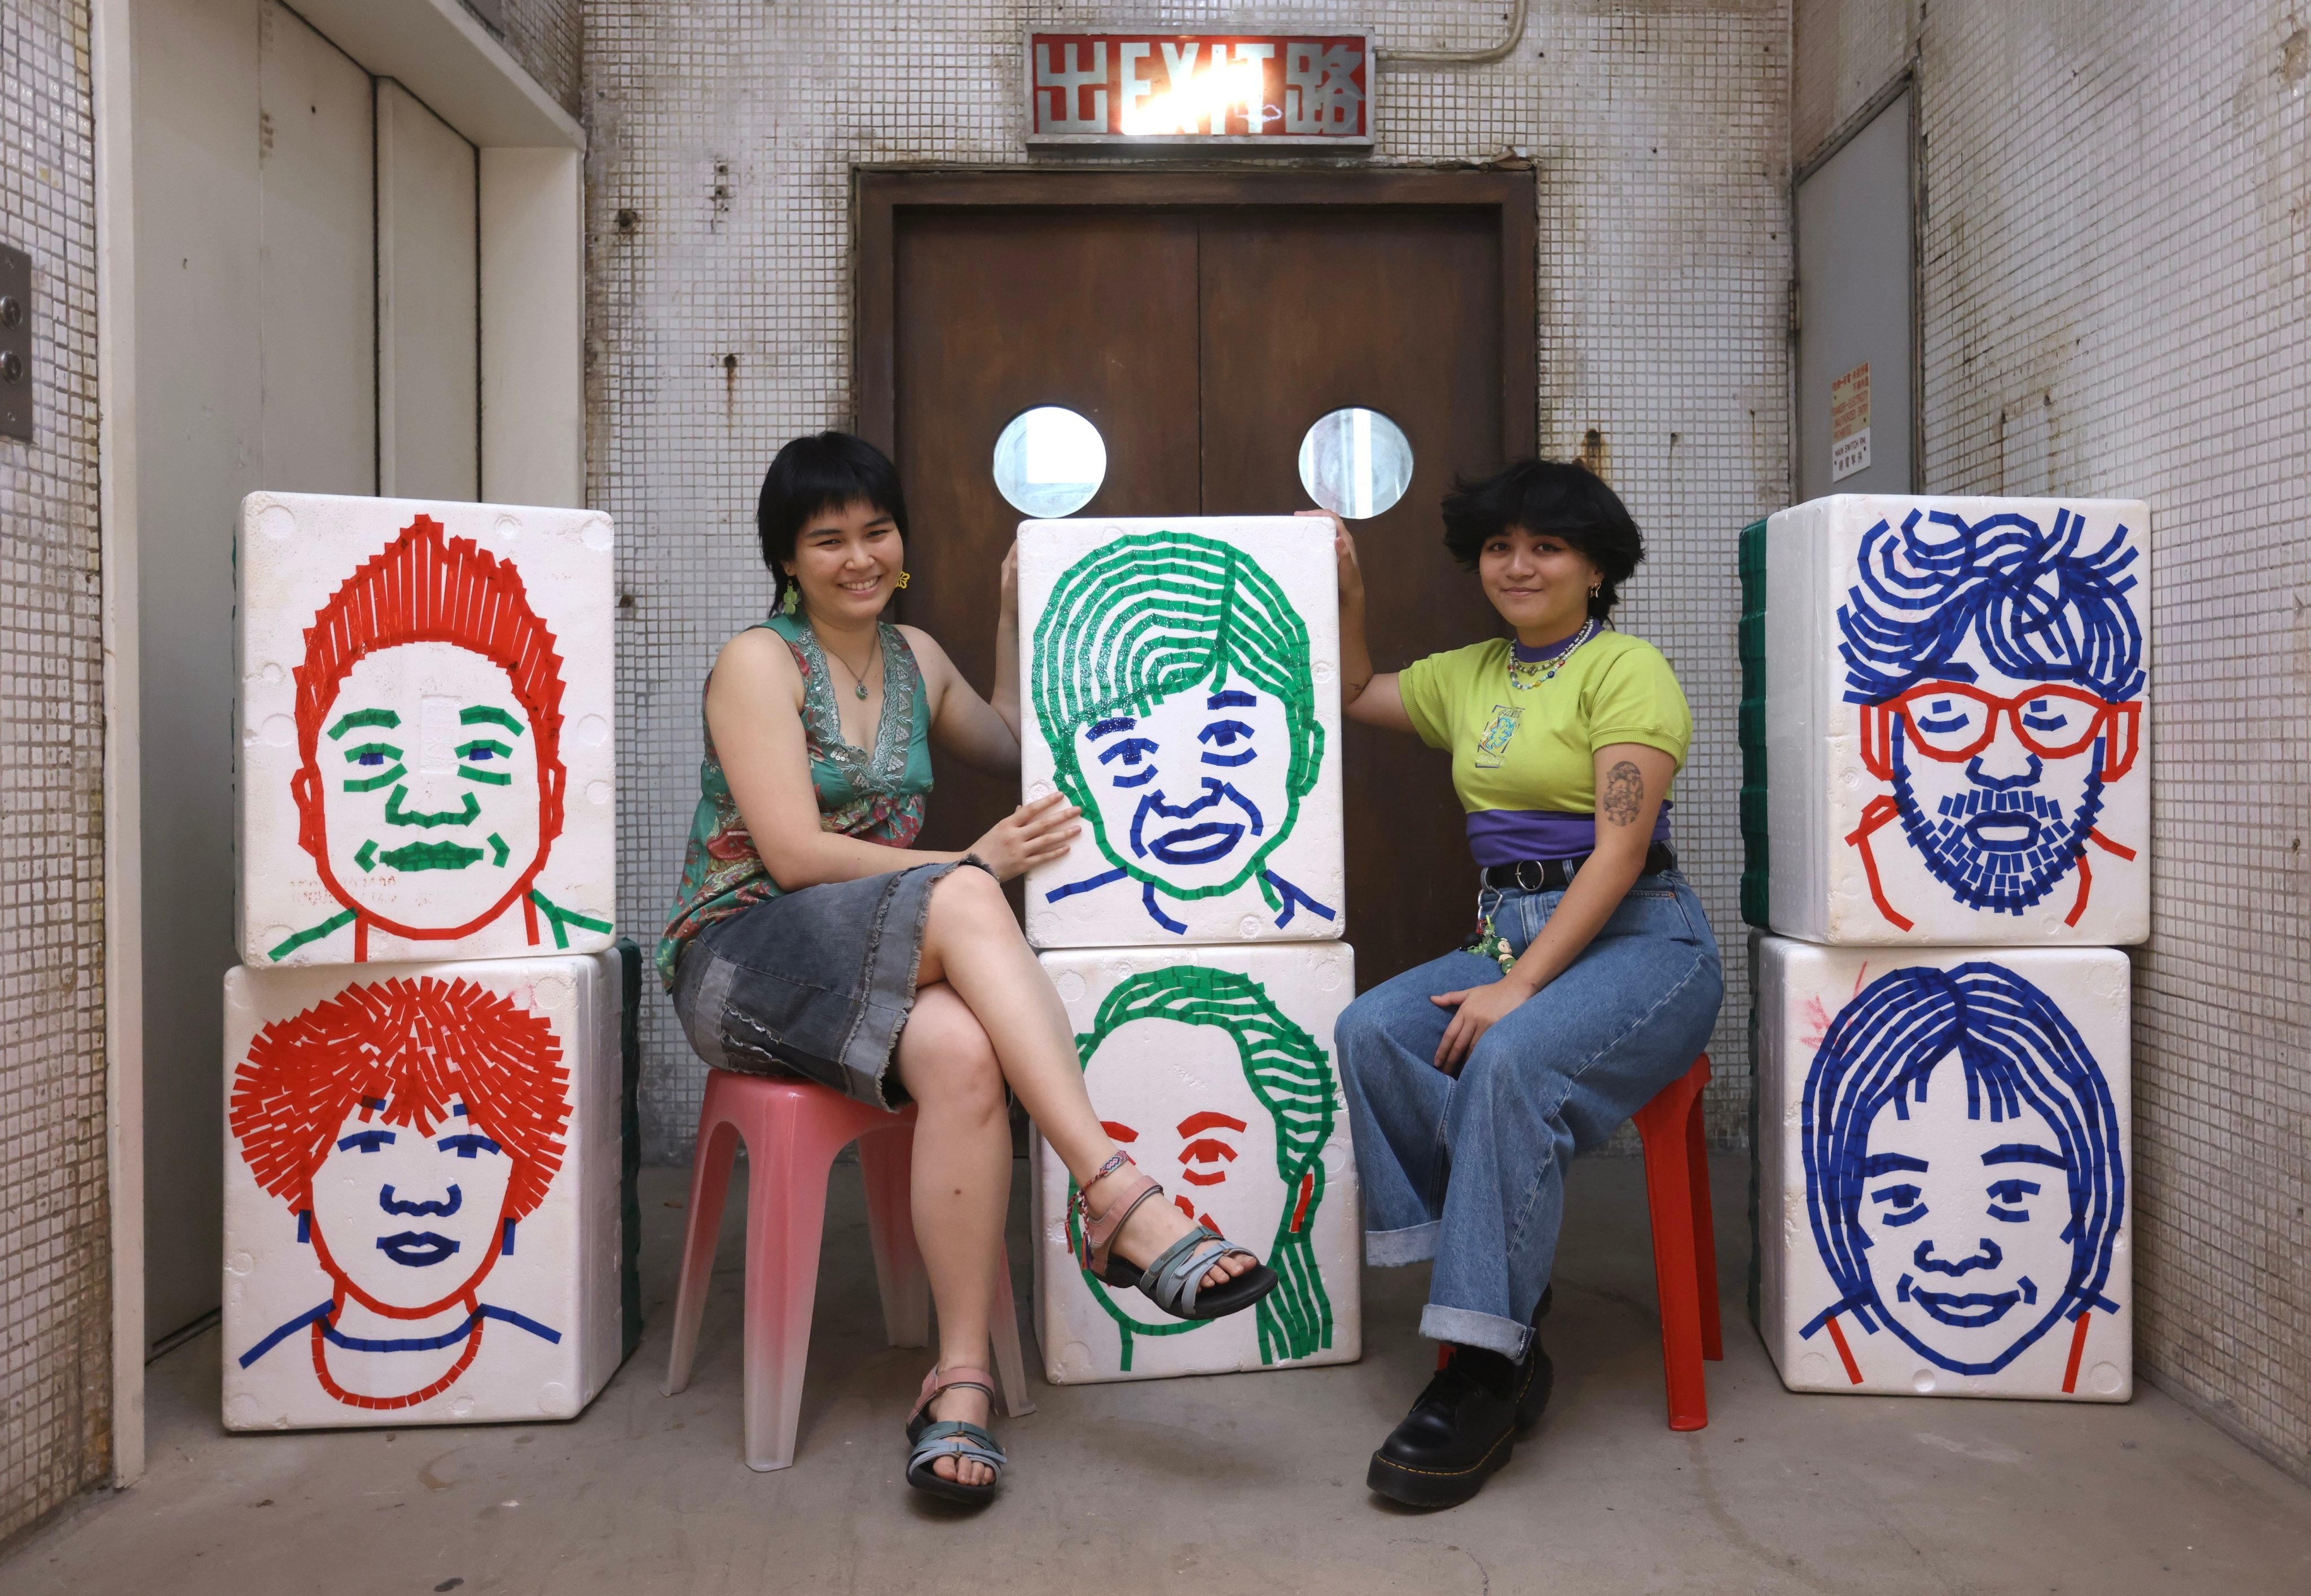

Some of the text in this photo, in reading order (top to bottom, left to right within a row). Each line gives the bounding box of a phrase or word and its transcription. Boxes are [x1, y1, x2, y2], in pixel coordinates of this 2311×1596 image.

[1036, 42, 1365, 135] 出 EXIT 路
[1844, 439, 1859, 453] SWITCH
